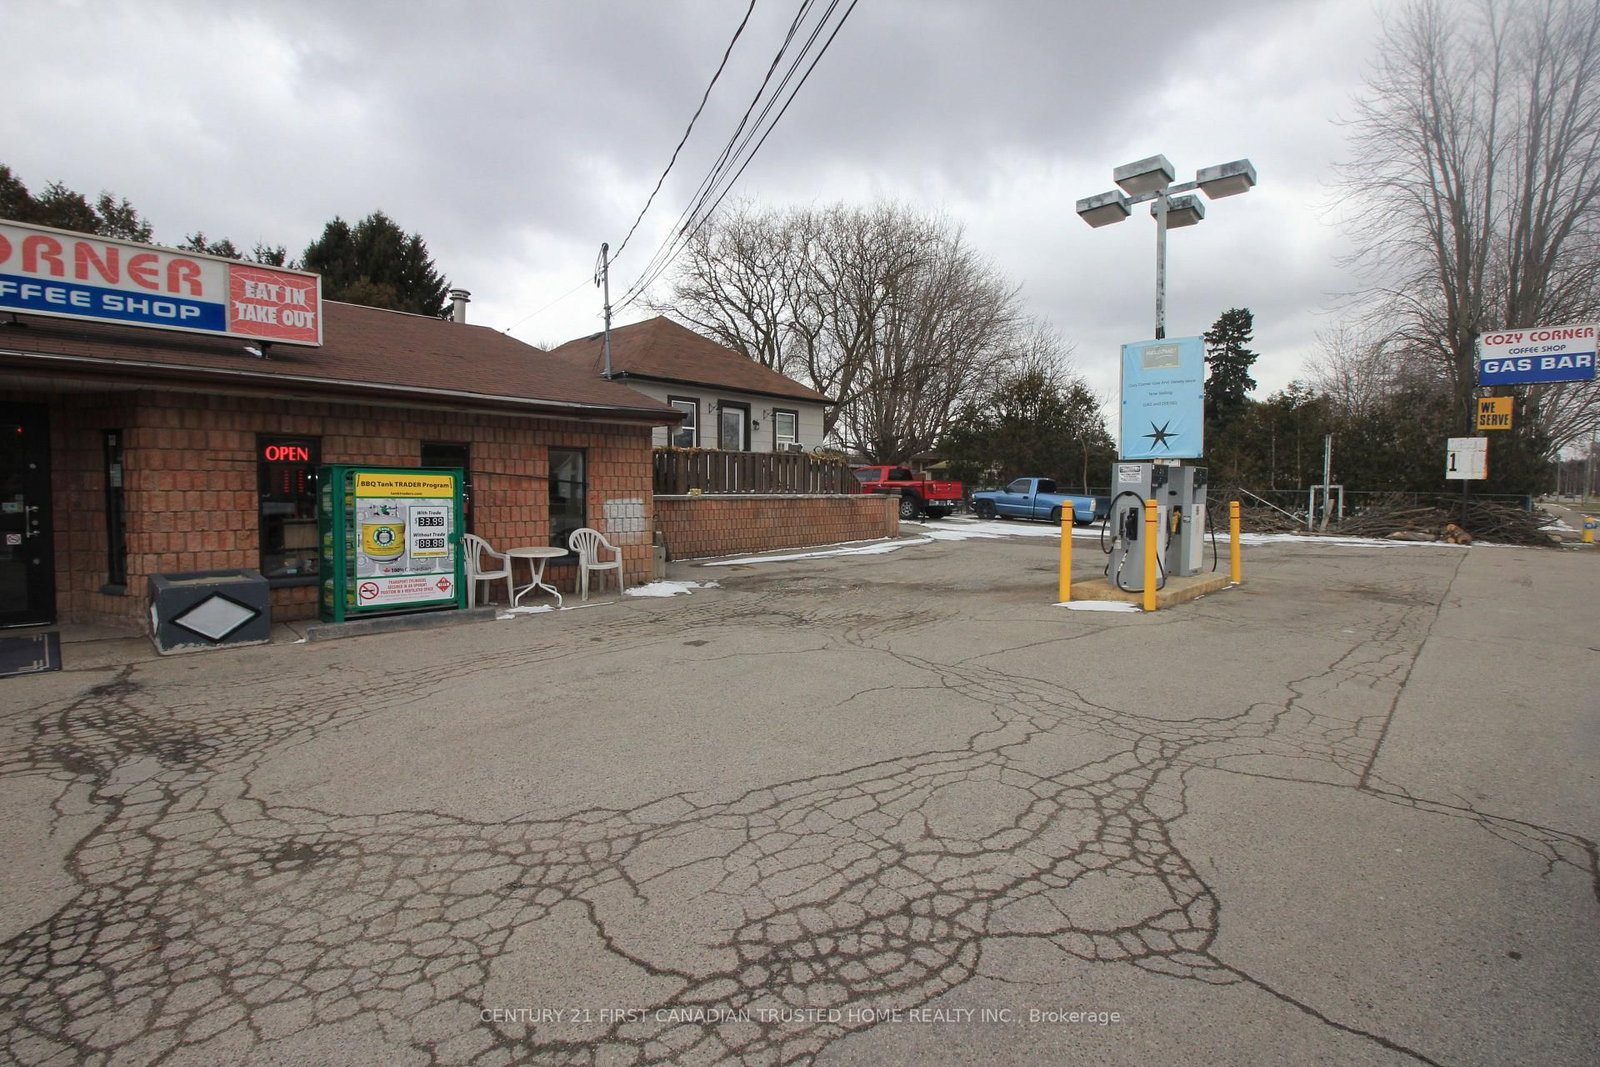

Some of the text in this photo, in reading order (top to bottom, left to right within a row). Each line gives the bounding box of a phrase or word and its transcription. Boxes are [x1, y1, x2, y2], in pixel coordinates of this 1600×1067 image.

[244, 280, 306, 304] EAT IN
[102, 294, 200, 319] SHOP
[235, 300, 316, 329] TAKE OUT
[1484, 326, 1594, 346] COZY CORNER
[1508, 344, 1566, 355] COFFEE SHOP
[1484, 354, 1592, 374] GAS BAR
[1480, 402, 1496, 413] WE
[1480, 414, 1509, 426] SERVE
[265, 445, 309, 461] OPEN
[1448, 452, 1457, 472] 1
